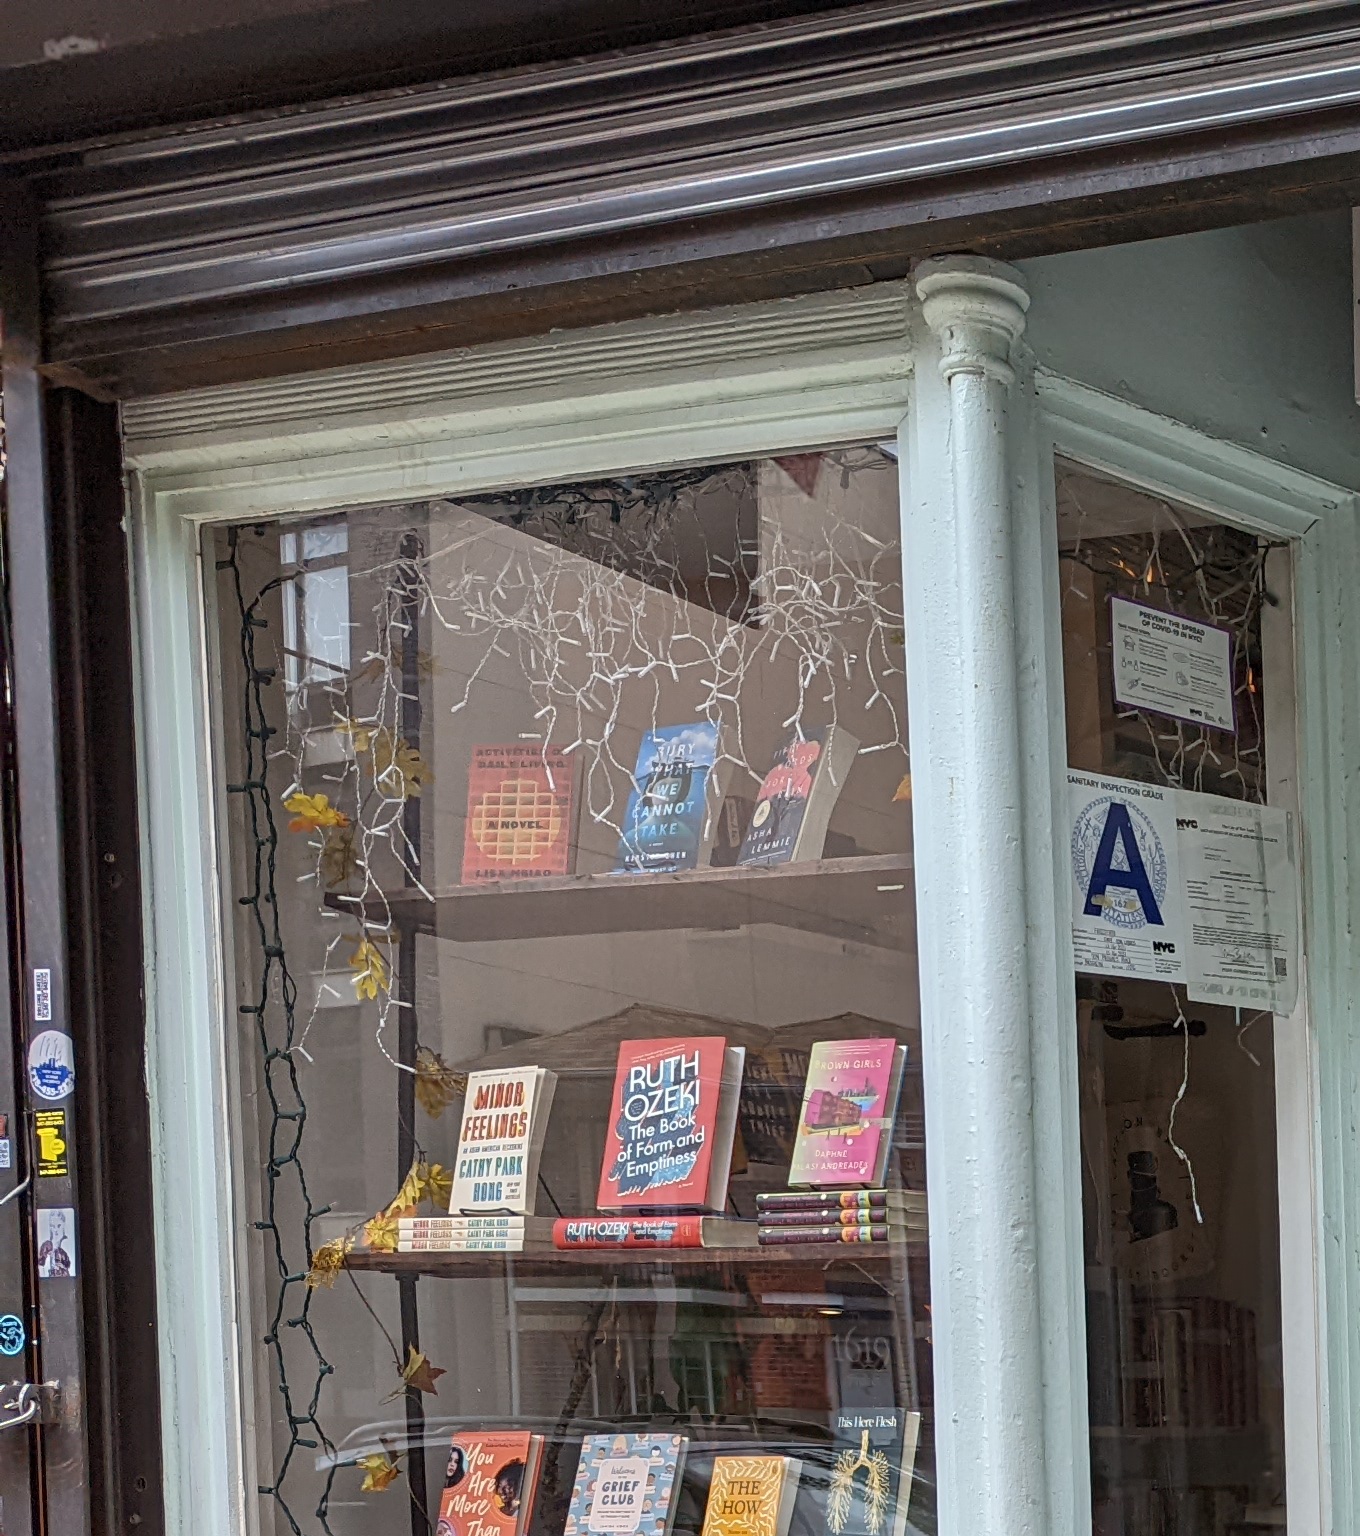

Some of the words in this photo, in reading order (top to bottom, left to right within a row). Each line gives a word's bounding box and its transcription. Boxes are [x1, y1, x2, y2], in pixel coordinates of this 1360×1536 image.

[656, 783, 679, 796] WE
[1066, 774, 1100, 789] SANITARY
[1100, 781, 1141, 797] INSPECTION
[1141, 788, 1165, 801] GRADE
[500, 820, 544, 829] NOVEL
[641, 822, 678, 837] TAKE
[1083, 801, 1166, 927] A
[1152, 940, 1176, 954] NYC
[628, 1049, 700, 1093] RUTH
[852, 1058, 883, 1070] GIRLS
[474, 1080, 525, 1111] MINOR
[623, 1079, 701, 1122] OZEKI
[462, 1111, 529, 1143] FEELINGS
[628, 1125, 656, 1141] The
[659, 1115, 696, 1137] Book
[616, 1143, 633, 1163] of
[635, 1140, 674, 1158] Form
[676, 1126, 706, 1147] and
[458, 1157, 493, 1179] CATHY
[494, 1155, 524, 1178] PARK
[626, 1150, 698, 1178] Emptiness
[472, 1181, 503, 1202] HONG
[566, 1222, 596, 1236] RUTH
[597, 1221, 630, 1236] OZEKI
[831, 1326, 891, 1368] 1619
[465, 1442, 495, 1474] You
[467, 1471, 497, 1497] Are
[601, 1480, 641, 1493] GRIEF
[727, 1480, 762, 1496] THE
[446, 1494, 491, 1518] More
[601, 1494, 635, 1506] CLUB
[721, 1499, 763, 1515] HOW
